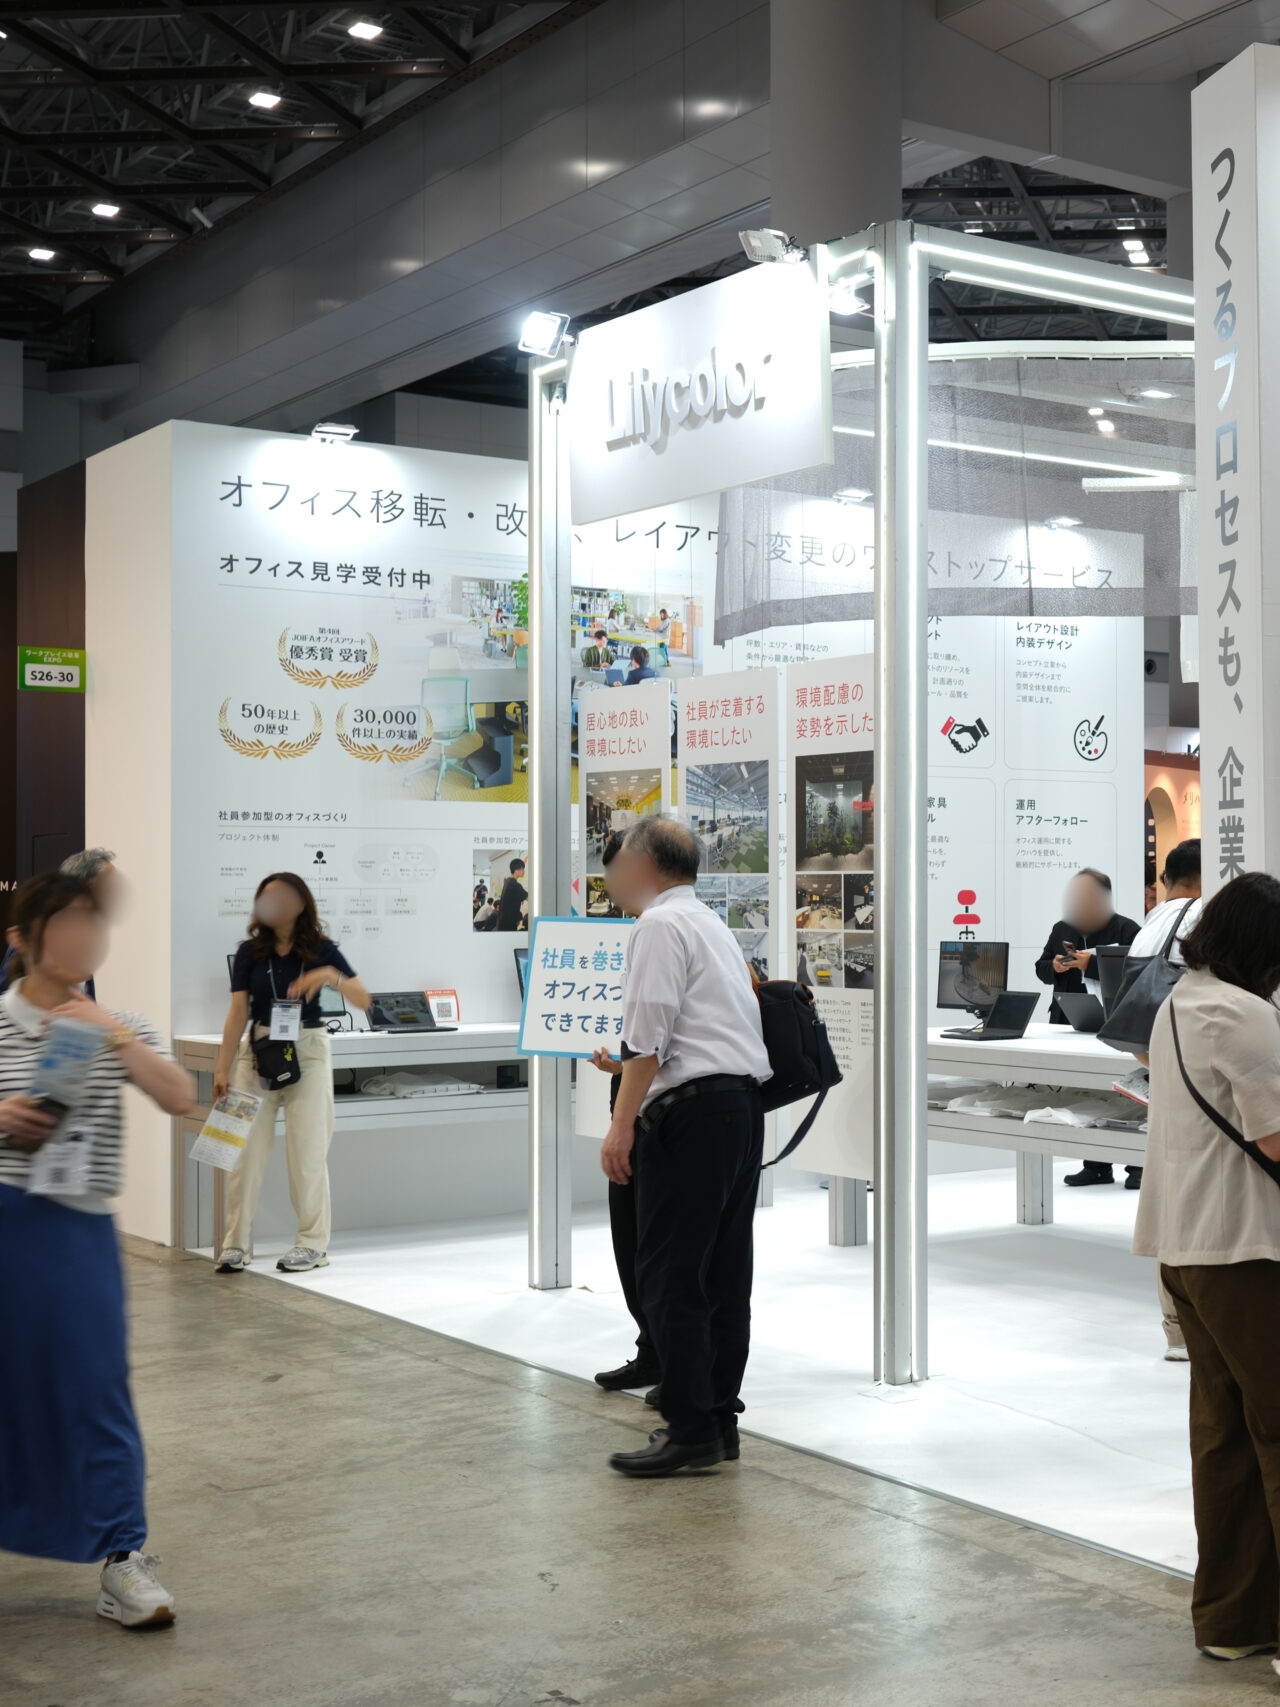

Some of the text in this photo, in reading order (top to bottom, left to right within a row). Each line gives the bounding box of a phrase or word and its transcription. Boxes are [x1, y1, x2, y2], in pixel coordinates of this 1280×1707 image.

[219, 554, 432, 590] オフィス見学受付中
[1016, 621, 1080, 637] レイアウト設計
[1016, 636, 1073, 651] 内装デザイン
[290, 644, 368, 664] 優秀賞 受賞
[30, 670, 74, 683] S26-30
[796, 683, 864, 709] 環境配慮の
[240, 703, 301, 722] 50年以上
[353, 708, 417, 727] 30,000
[686, 695, 766, 722] 社員が定着する
[253, 722, 289, 737] の歴史
[586, 710, 649, 732] 居心地の良い
[796, 713, 874, 740] 姿勢を示した
[351, 727, 418, 742] 件以上の実績
[686, 726, 752, 750] 環境にしたい
[586, 736, 647, 758] 環境にしたい
[1016, 799, 1036, 811] 運用
[218, 810, 348, 824] 社員参加型のオフィスづくり
[1016, 814, 1089, 827] アフターフォロー
[217, 832, 280, 843] プロジェクト体制
[541, 948, 629, 972] 社員を巻き
